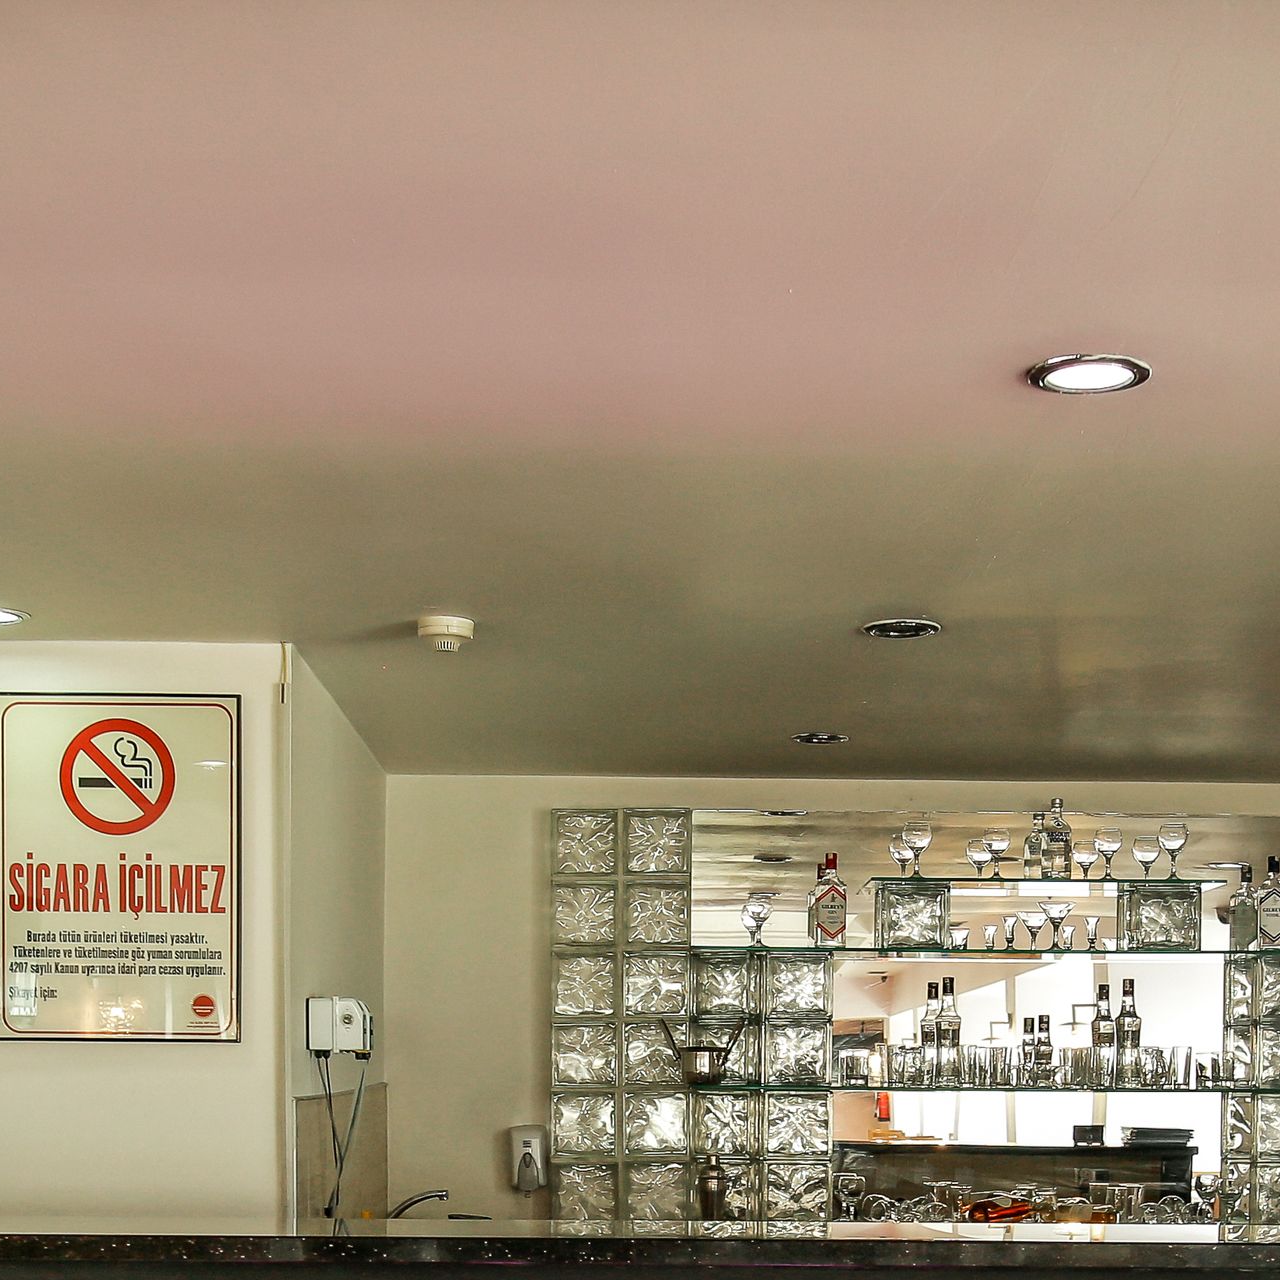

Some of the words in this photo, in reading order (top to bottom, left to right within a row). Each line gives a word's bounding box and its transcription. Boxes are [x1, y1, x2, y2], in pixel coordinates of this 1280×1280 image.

[9, 853, 110, 912] SİGARA
[120, 853, 226, 920] İÇİLMEZ
[26, 930, 56, 942] Burada
[59, 931, 81, 943] tütün
[84, 931, 117, 943] ürünleri
[120, 931, 167, 944] tüketilmesi
[170, 932, 208, 945] yasaktır.
[13, 945, 60, 958] Tüketenlere
[62, 948, 72, 958] ve
[74, 946, 129, 958] tüketilmesine
[131, 947, 145, 961] göz
[147, 950, 172, 961] yuman
[175, 948, 222, 959] sorumlulara
[9, 962, 28, 973] 4207
[30, 962, 52, 976] sayılı
[54, 962, 79, 974] Kanun
[81, 964, 115, 976] uyarınca
[118, 963, 136, 974] idari
[138, 965, 156, 977] para
[158, 965, 184, 975] cezası
[186, 963, 226, 977] uygulanır.
[40, 986, 57, 1001] için:
